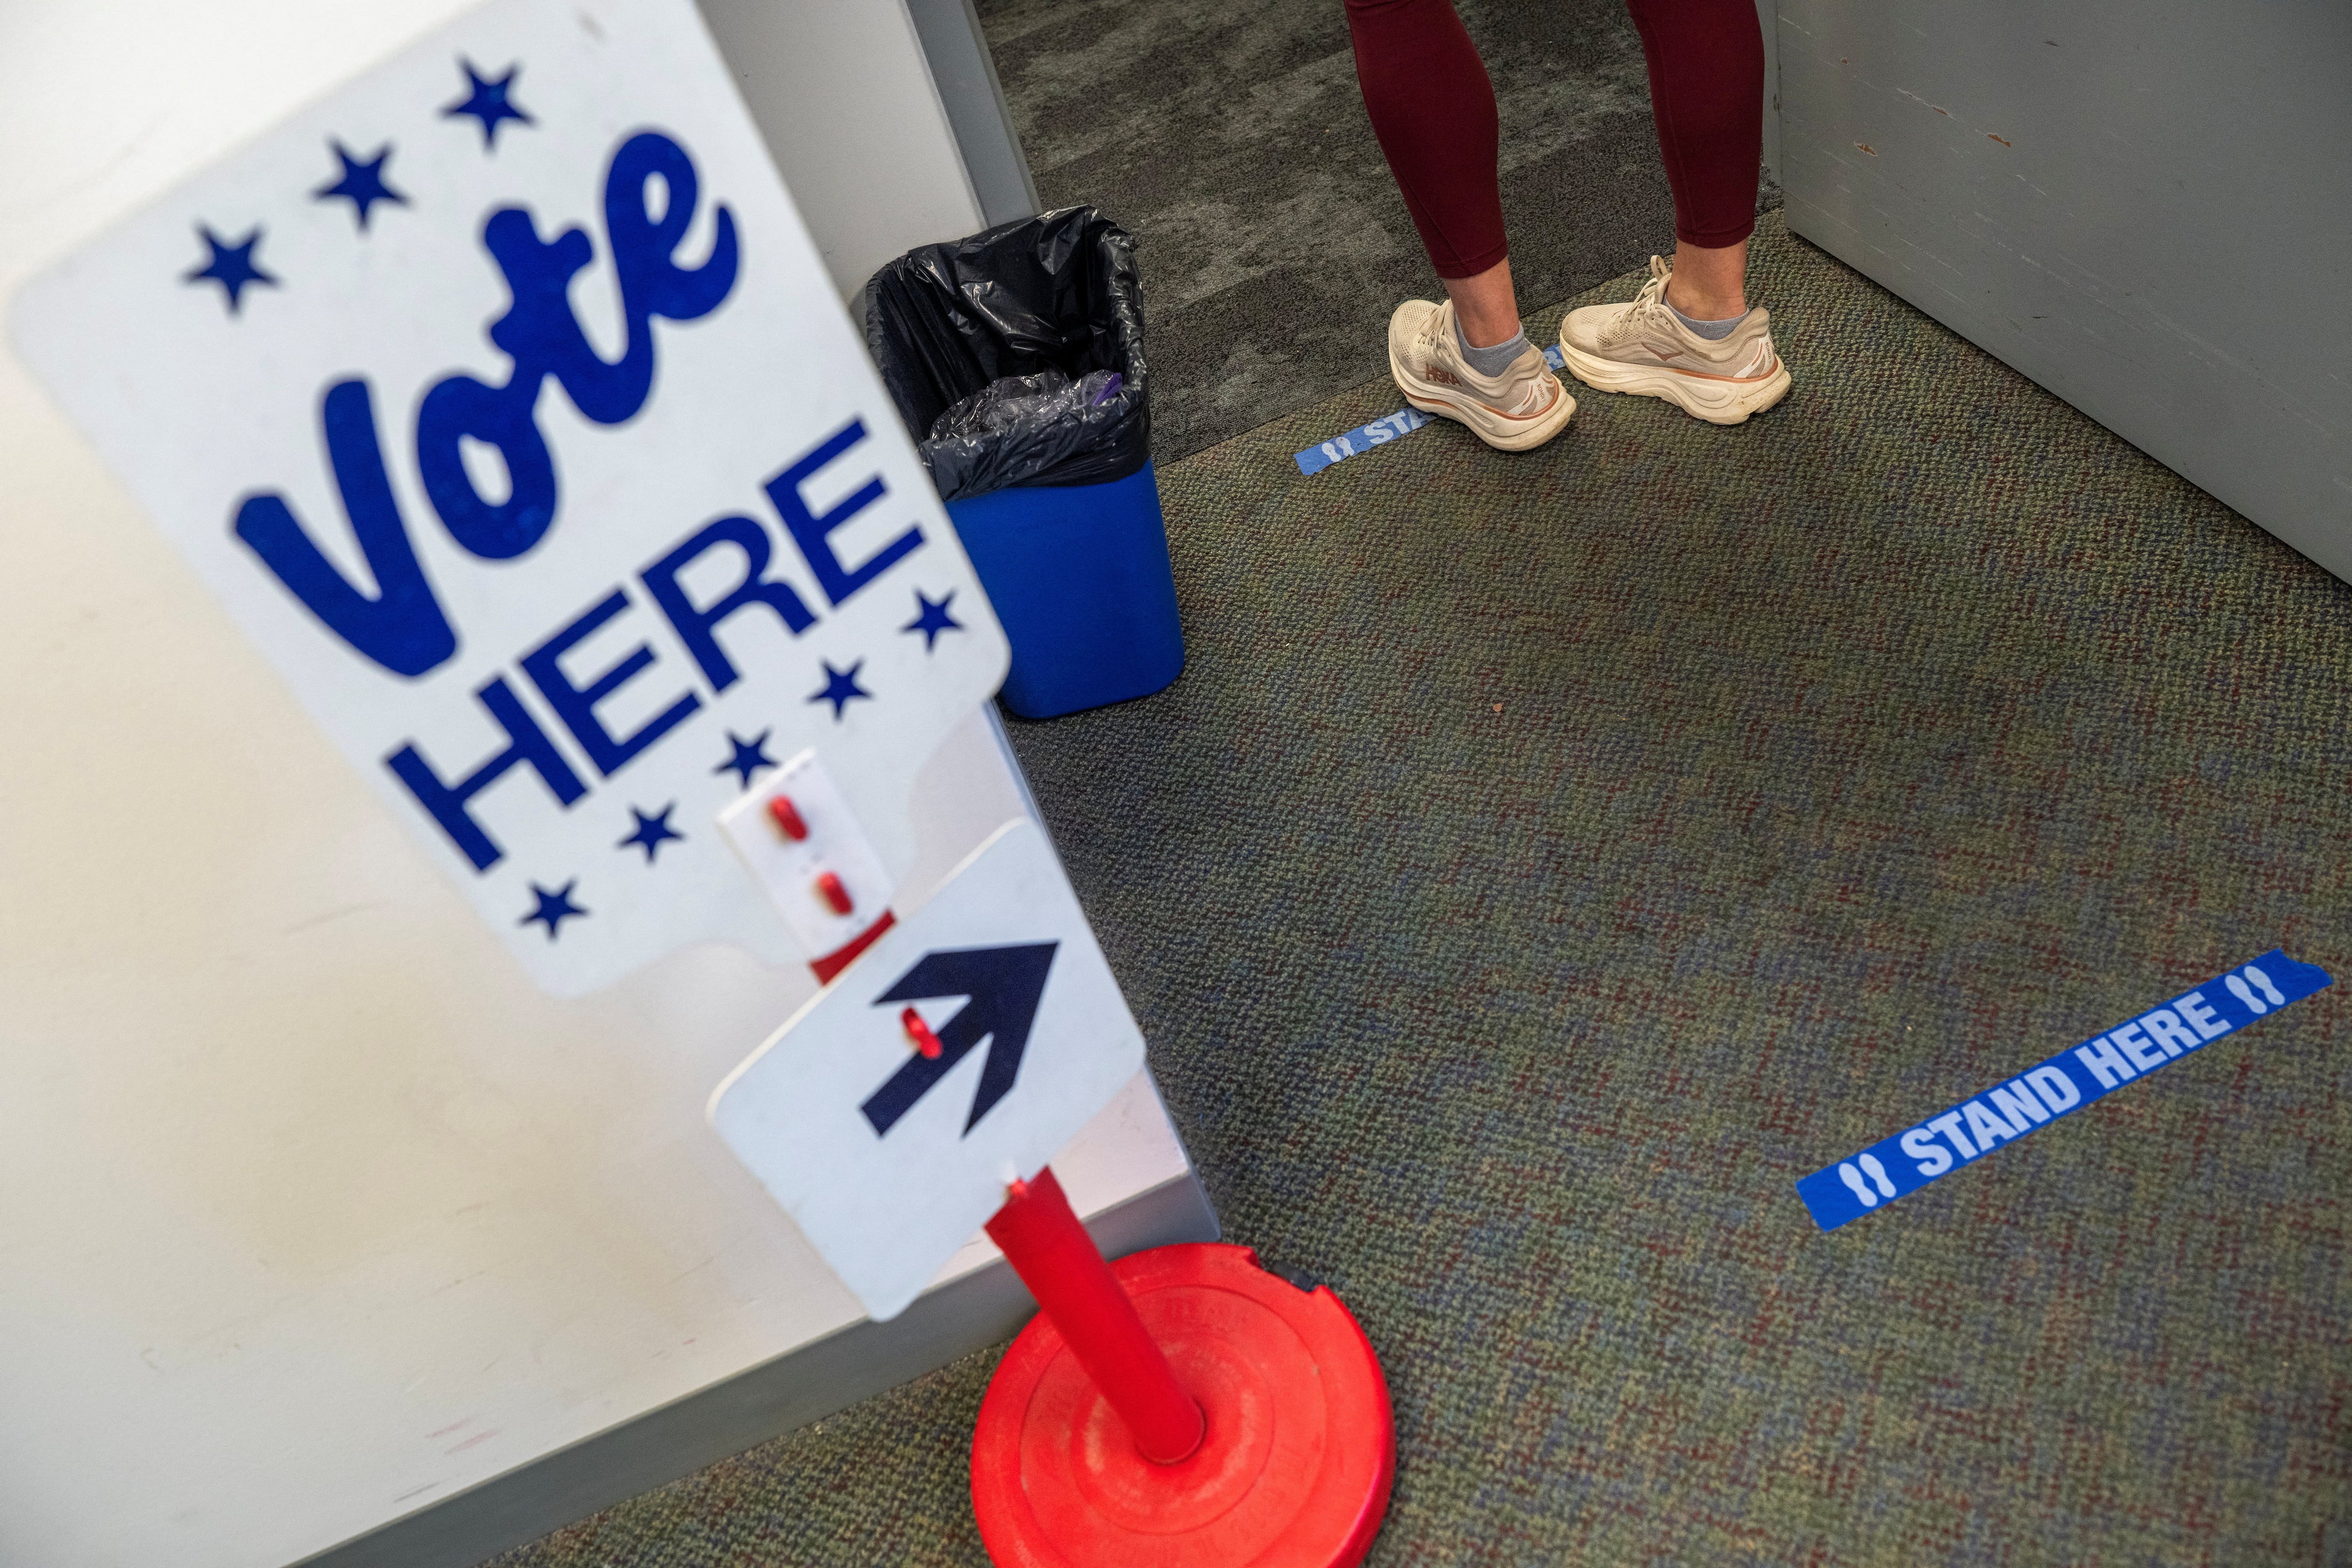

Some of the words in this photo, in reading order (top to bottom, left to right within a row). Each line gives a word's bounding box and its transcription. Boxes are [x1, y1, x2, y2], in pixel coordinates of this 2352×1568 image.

[232, 130, 740, 679] Vote
[1364, 406, 1438, 444] STA
[1536, 383, 1546, 399] BONDI
[385, 418, 926, 873] HERE
[1900, 1065, 2081, 1177] STAND
[2074, 991, 2232, 1089] HERE
